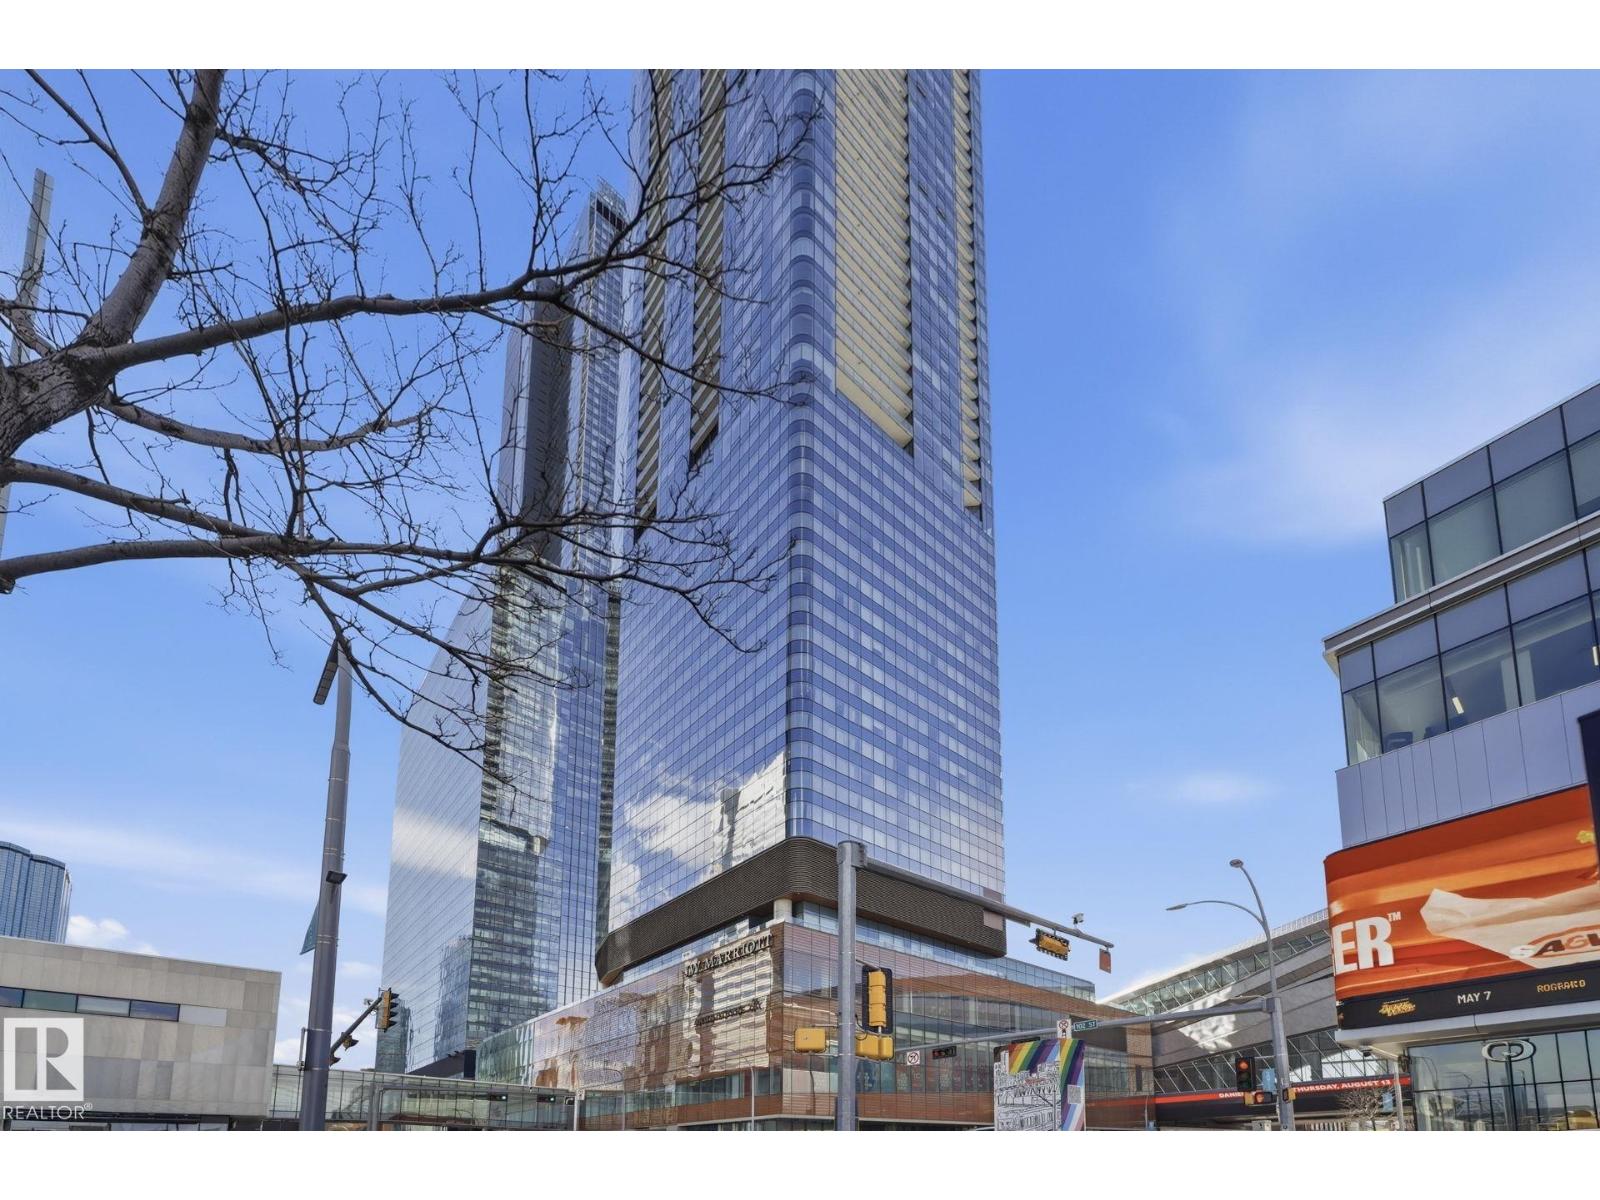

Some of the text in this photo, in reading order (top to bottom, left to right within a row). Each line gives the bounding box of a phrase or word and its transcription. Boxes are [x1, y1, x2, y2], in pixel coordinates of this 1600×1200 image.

[704, 932, 774, 970] MARRIOTT
[1457, 991, 1491, 1005] MAY 7
[1076, 1022, 1086, 1030] 102
[1341, 1080, 1378, 1089] AUGUST
